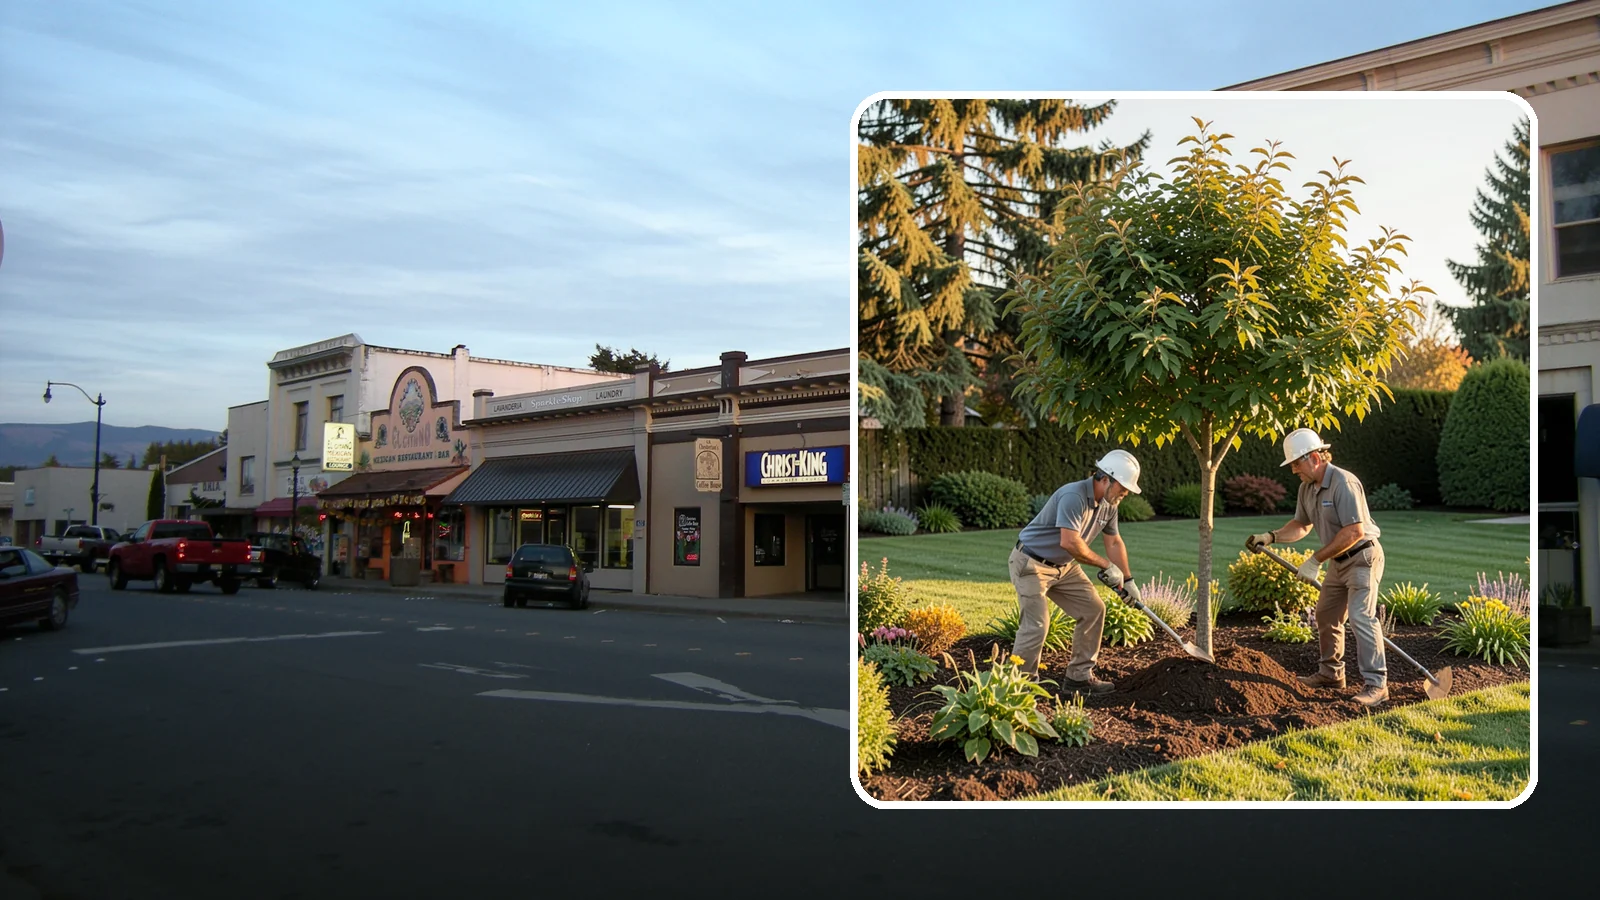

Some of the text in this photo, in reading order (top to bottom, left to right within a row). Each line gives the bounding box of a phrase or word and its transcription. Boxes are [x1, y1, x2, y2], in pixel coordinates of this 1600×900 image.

[493, 402, 522, 412] LAVANDERIA
[561, 394, 582, 405] Shop
[595, 389, 623, 400] LAUNDRY
[373, 450, 450, 464] MEXICAN RESTAURANT BAR
[761, 450, 828, 478] CHRIST KING
[697, 480, 709, 489] Coffee
